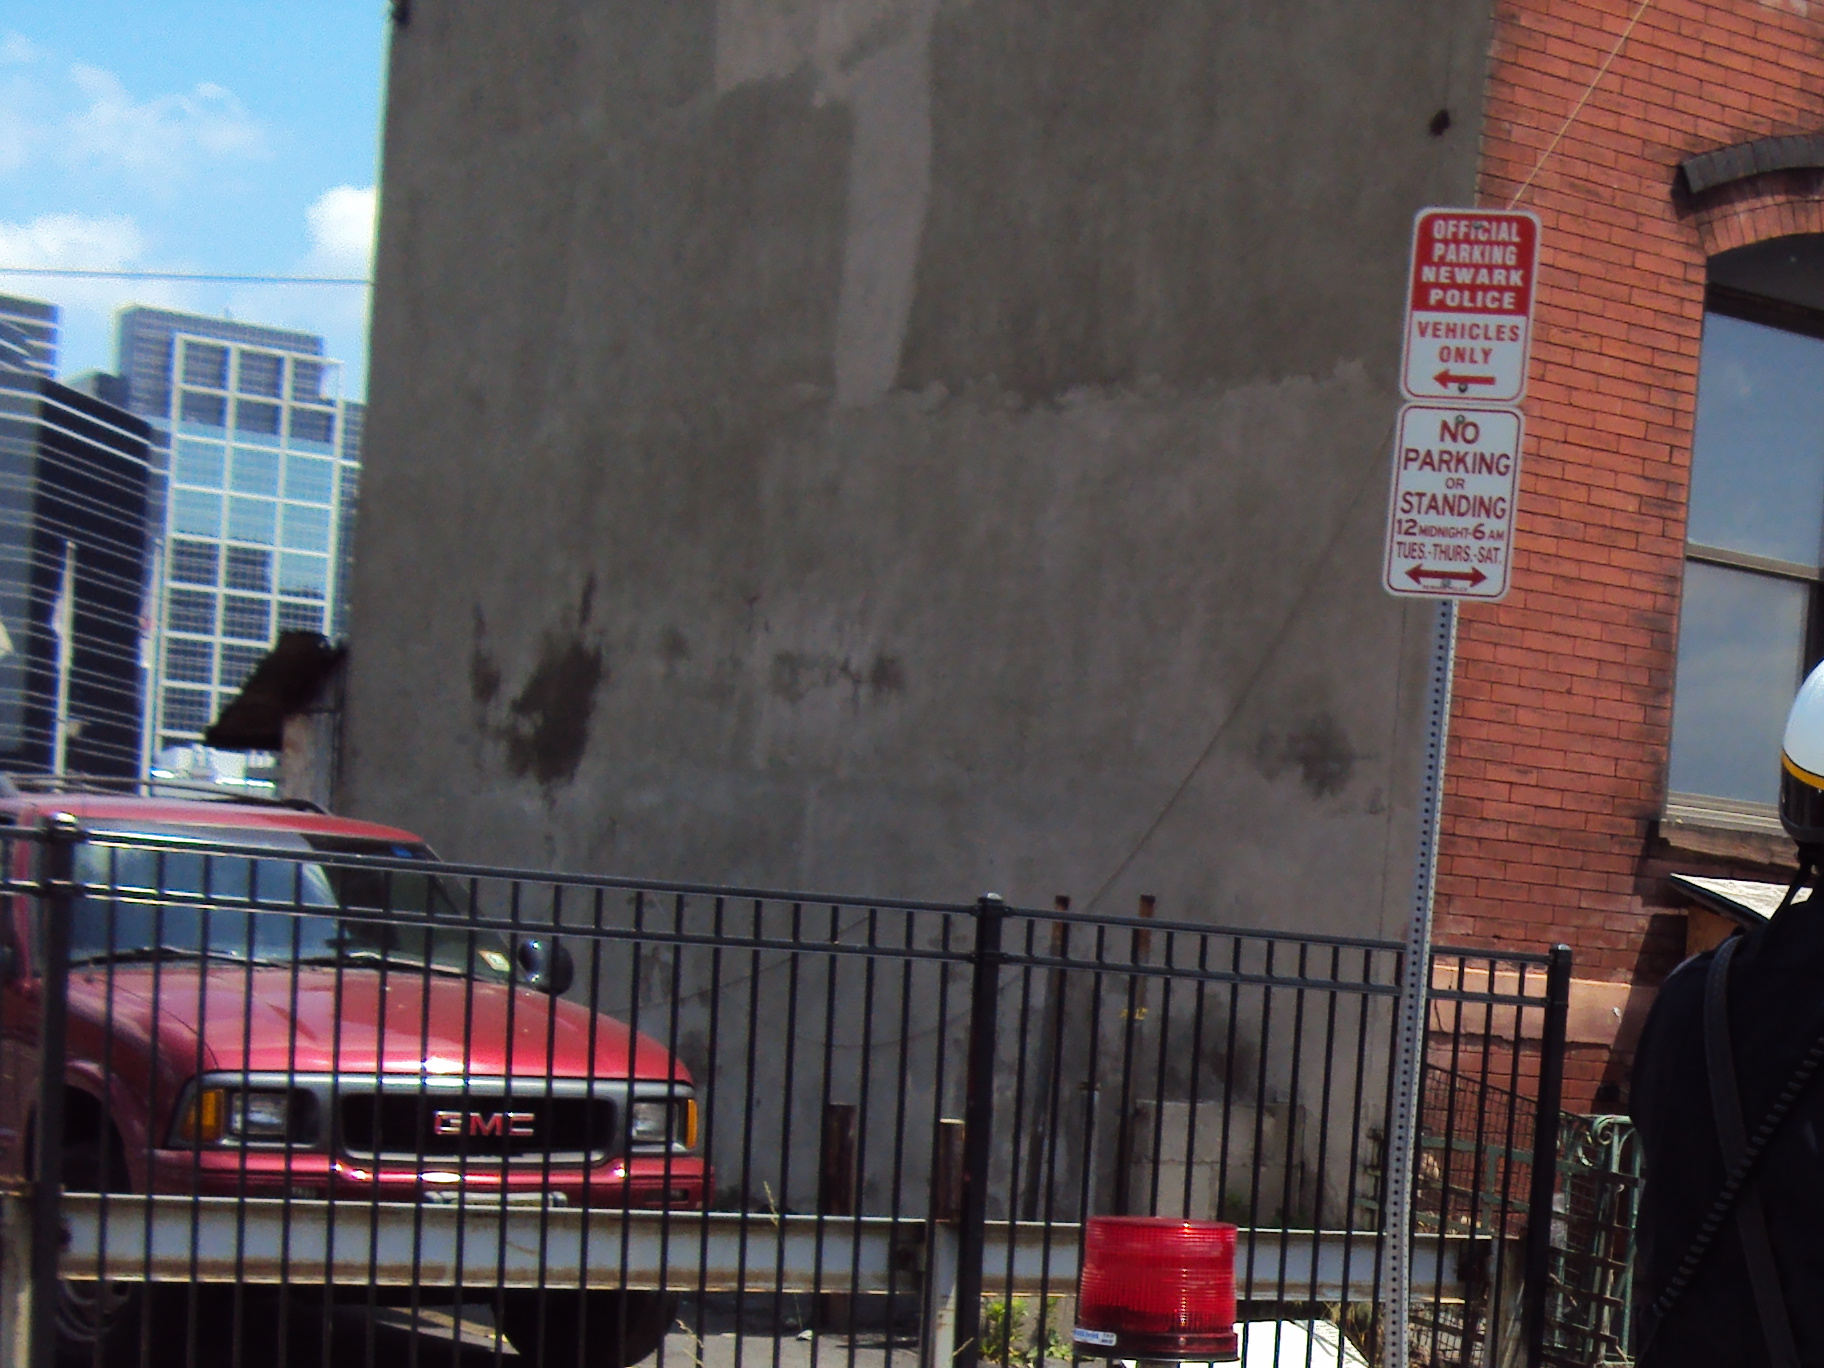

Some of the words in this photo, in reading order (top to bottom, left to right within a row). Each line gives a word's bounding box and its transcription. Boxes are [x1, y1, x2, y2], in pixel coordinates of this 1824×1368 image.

[1433, 220, 1520, 242] OFFICIAL
[1432, 243, 1517, 265] PARKING
[1421, 266, 1523, 286] NEWARK
[1429, 290, 1515, 309] POLICE
[1417, 321, 1520, 341] VEHICLES
[1438, 346, 1493, 364] ONLY
[1439, 420, 1479, 444] NO
[1403, 448, 1511, 476] PARKING
[1445, 477, 1465, 489] OR
[1400, 492, 1506, 519] STANDING
[434, 1111, 535, 1136] GMC
